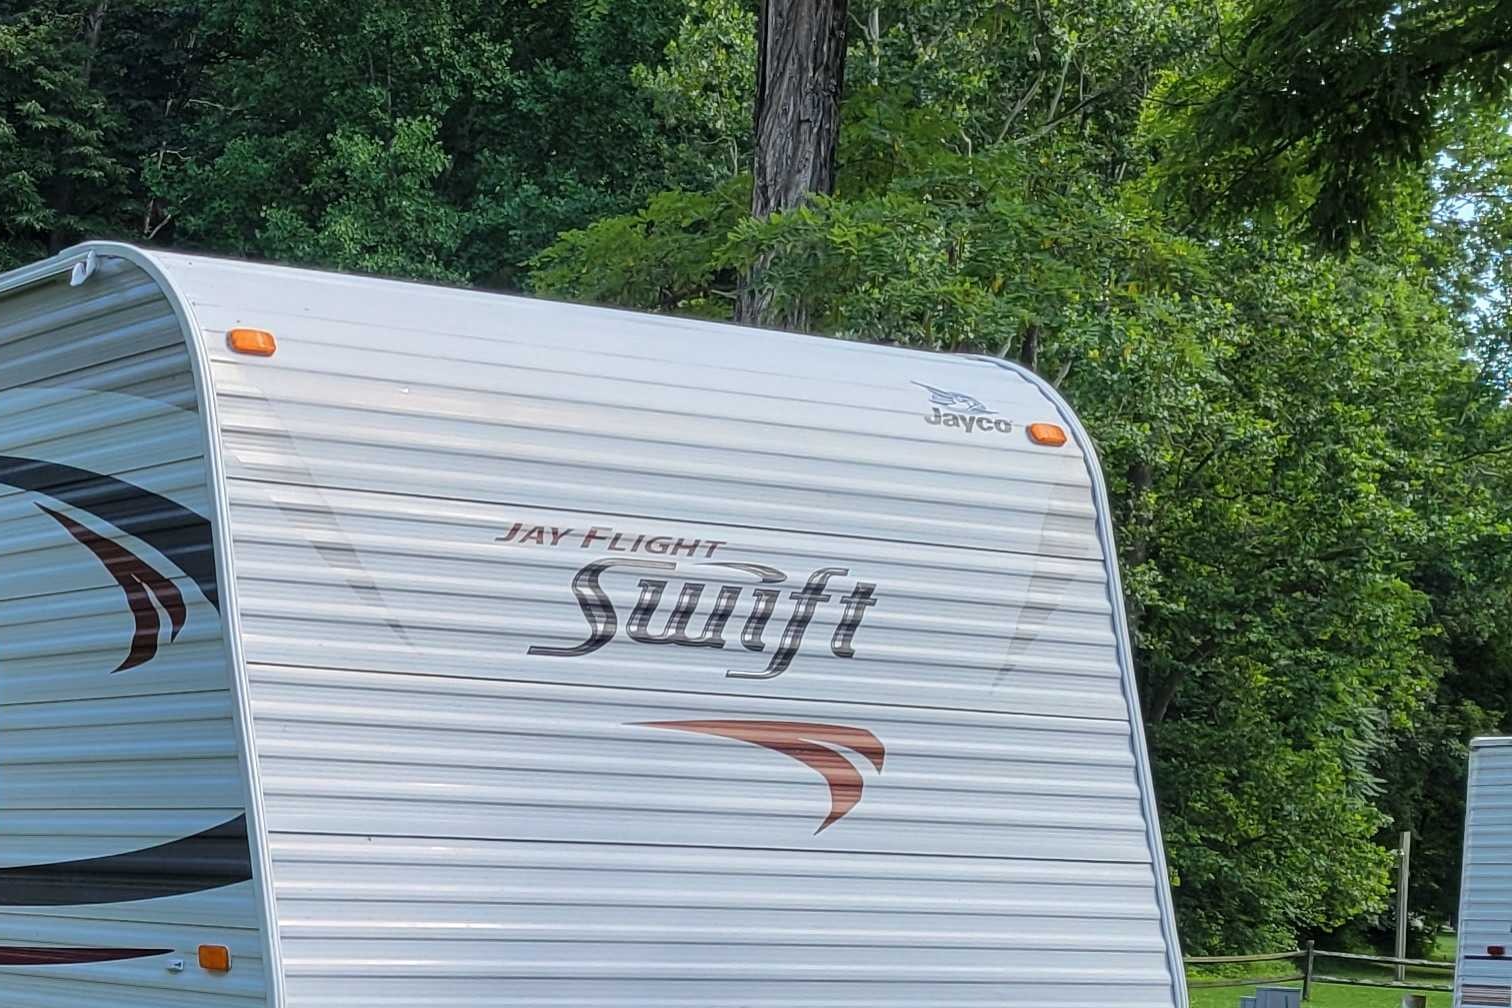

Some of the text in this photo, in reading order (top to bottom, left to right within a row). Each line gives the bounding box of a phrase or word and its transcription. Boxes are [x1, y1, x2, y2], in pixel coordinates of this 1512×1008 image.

[923, 407, 1013, 433] Jayco
[495, 522, 727, 558] JAY FLIGHT
[526, 557, 878, 680] Swift
